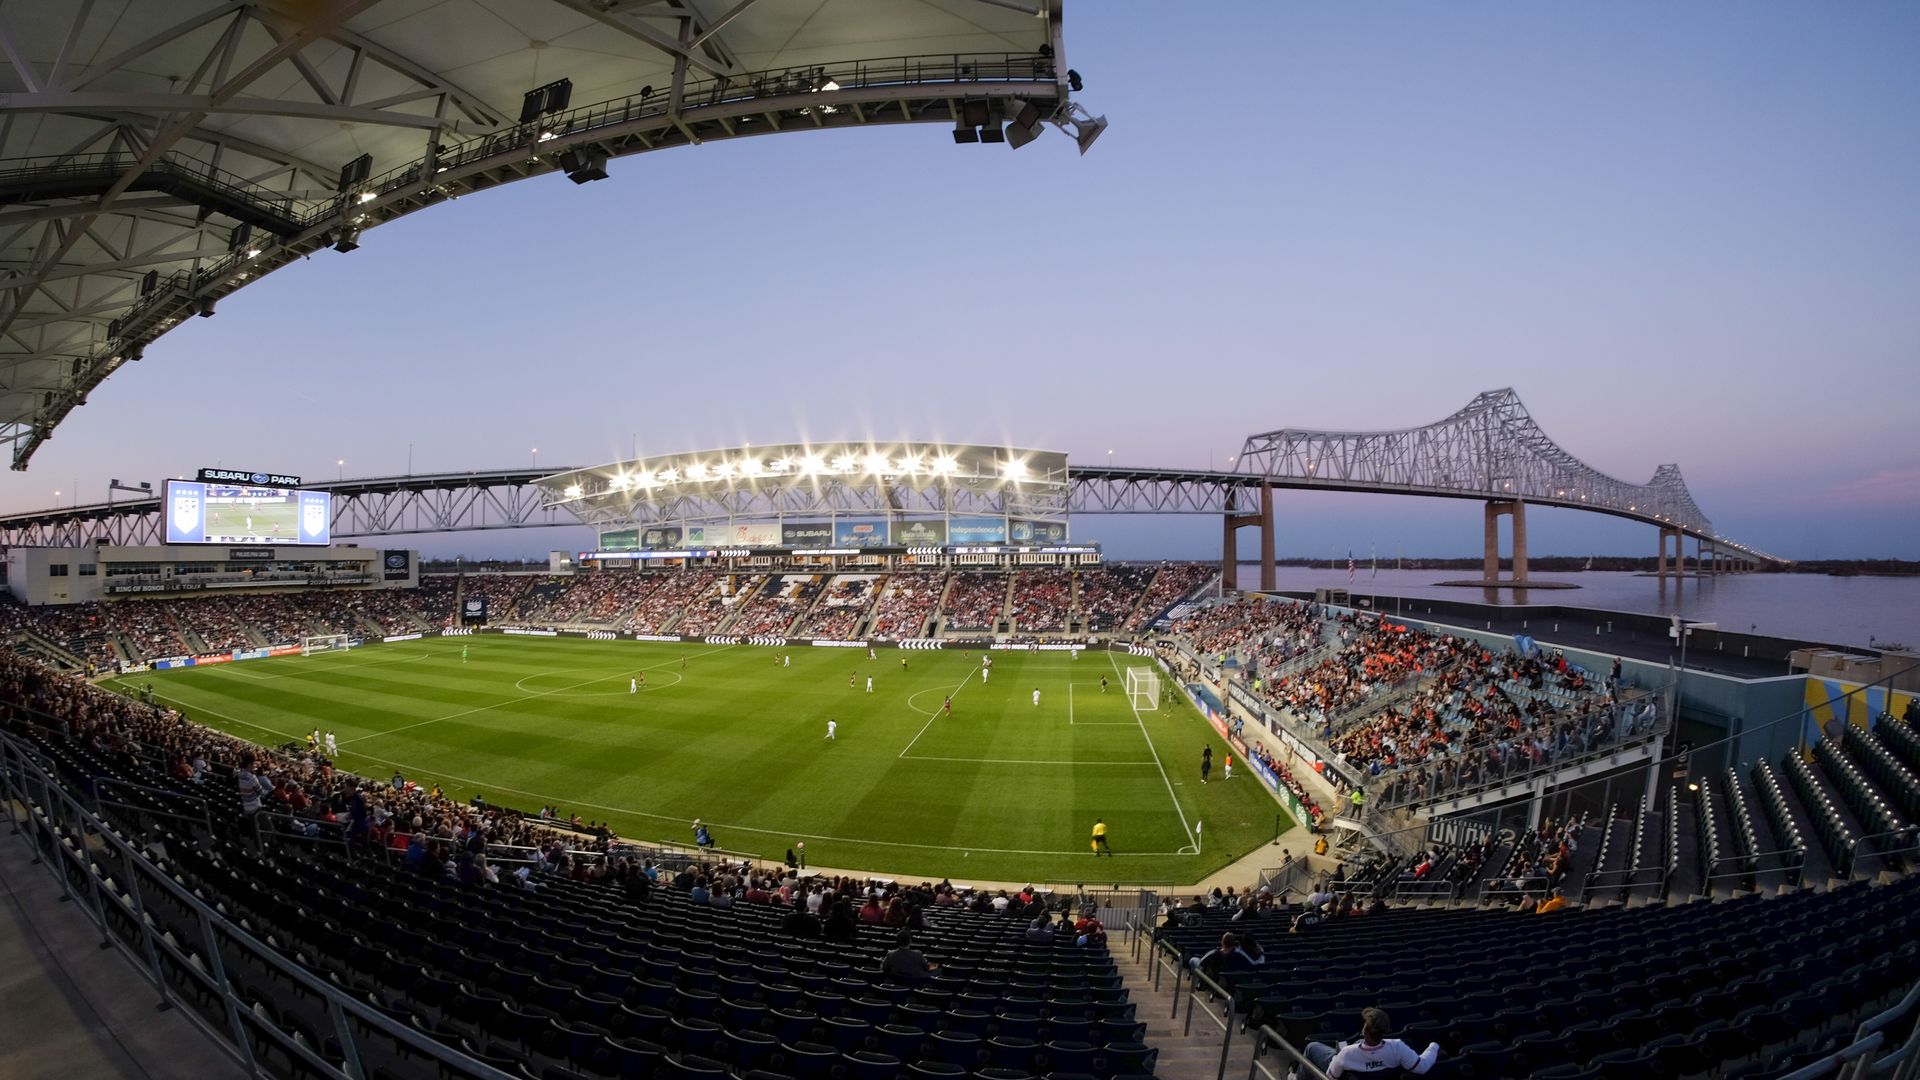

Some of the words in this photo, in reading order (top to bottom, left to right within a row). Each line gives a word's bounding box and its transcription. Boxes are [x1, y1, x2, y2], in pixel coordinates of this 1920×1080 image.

[205, 470, 249, 481] SUBARU
[271, 476, 299, 485] PARK
[950, 526, 996, 535] Independence
